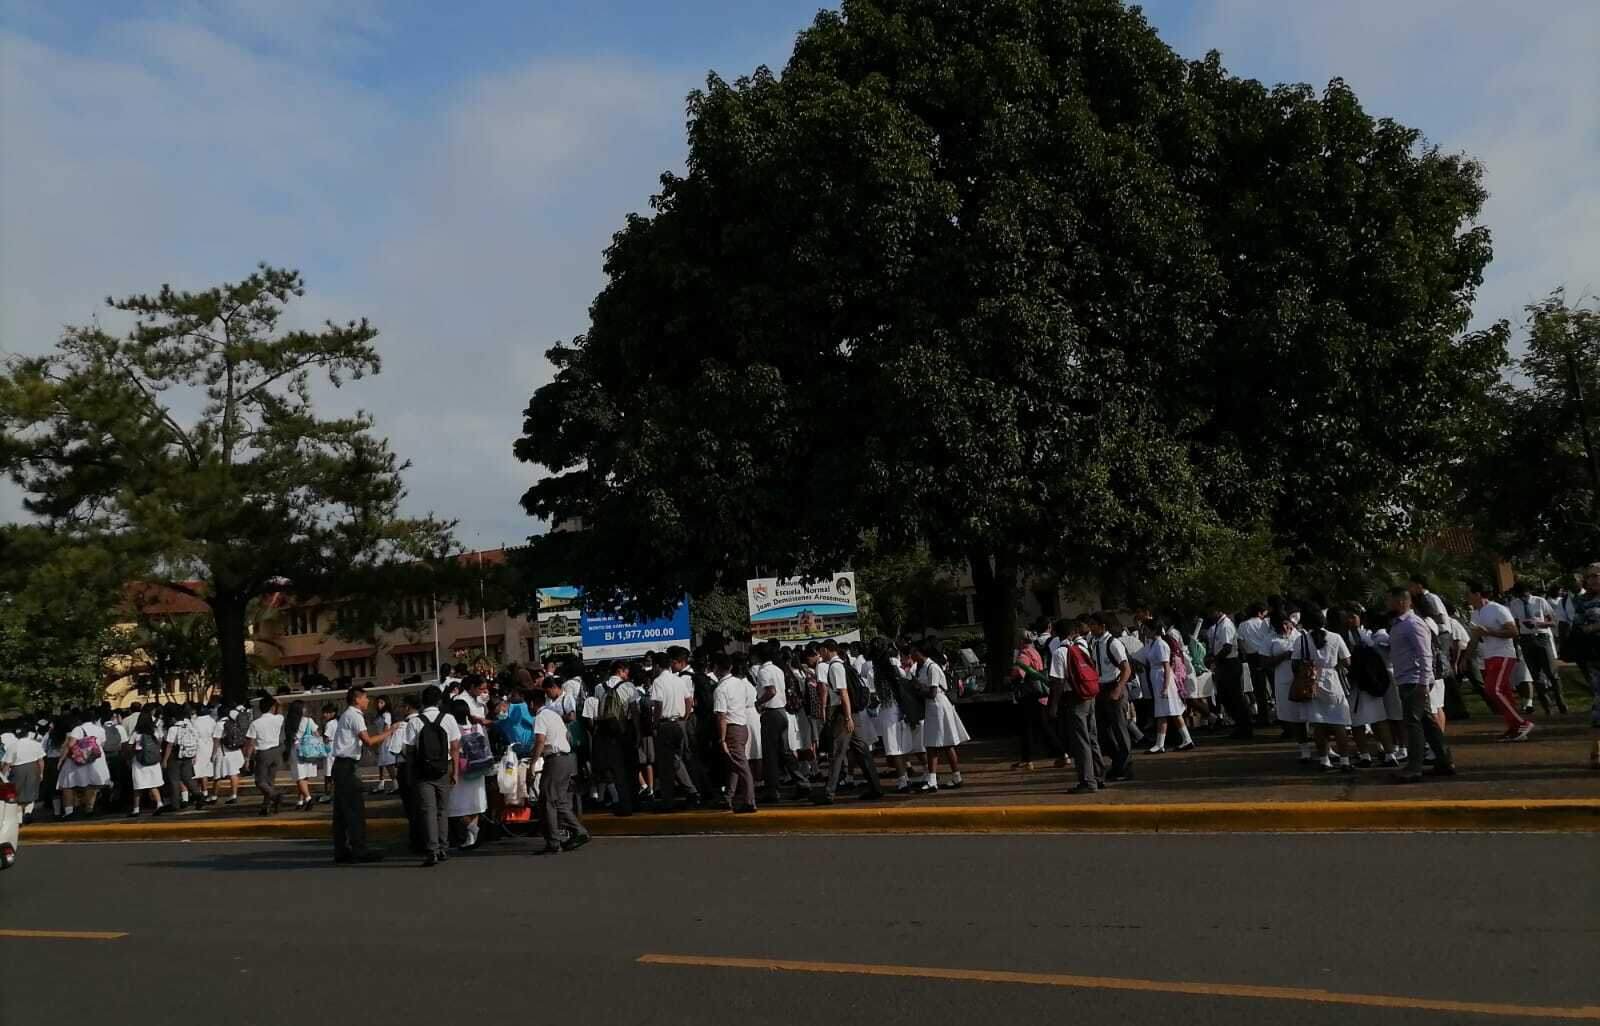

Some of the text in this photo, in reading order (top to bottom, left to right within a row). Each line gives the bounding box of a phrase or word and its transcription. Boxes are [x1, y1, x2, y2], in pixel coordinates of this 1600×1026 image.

[775, 585, 831, 596] Escuela Normal
[757, 602, 771, 611] Juan
